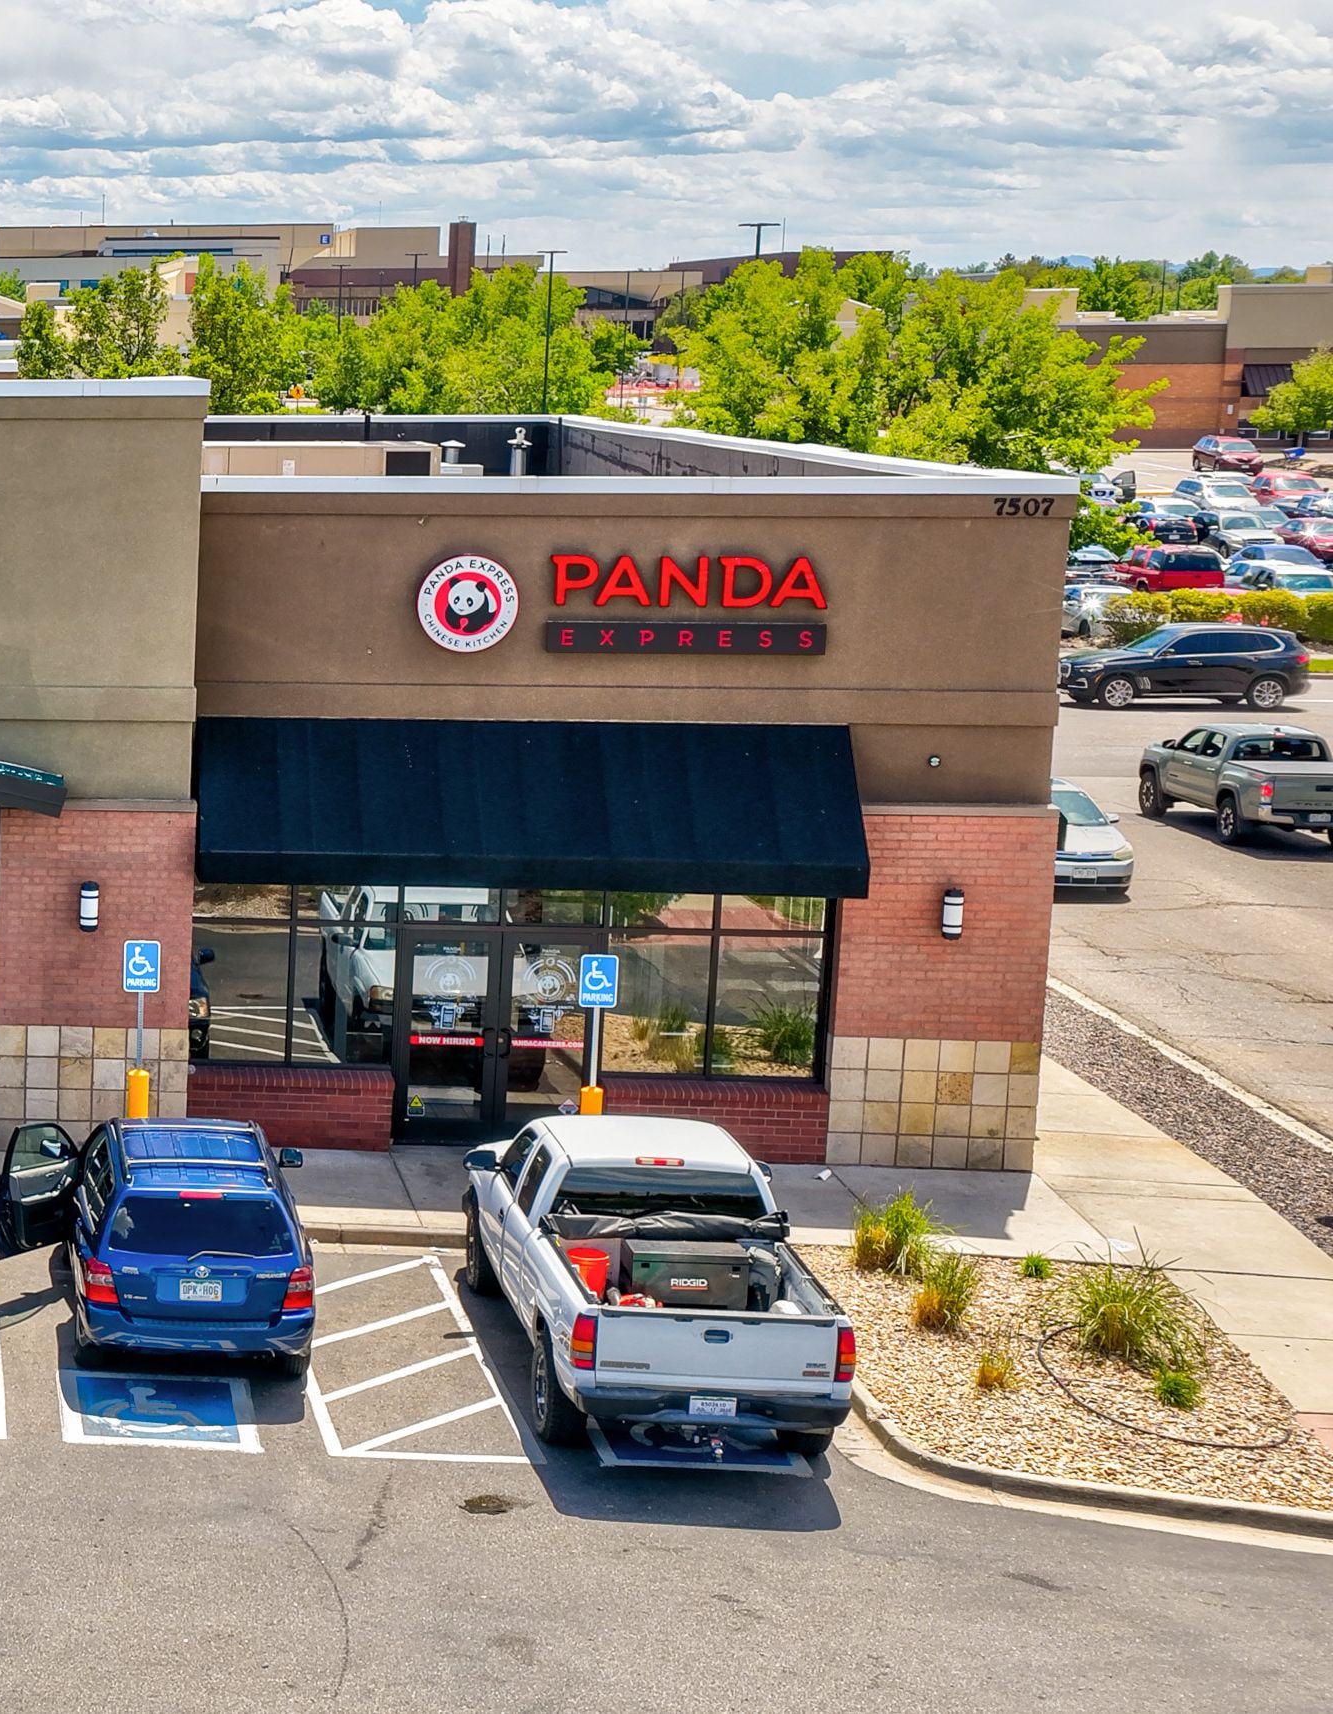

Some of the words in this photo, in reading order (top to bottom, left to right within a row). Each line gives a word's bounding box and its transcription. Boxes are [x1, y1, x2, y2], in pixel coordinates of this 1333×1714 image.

[993, 497, 1055, 517] 7507
[423, 561, 464, 596] PANDA
[469, 559, 515, 603] EXPRESS
[550, 554, 828, 609] PANDA
[424, 613, 460, 648] CHINESE
[465, 620, 508, 648] KITCHEN
[560, 629, 814, 649] EXPRESS
[126, 977, 157, 987] PARKING
[582, 993, 614, 1003] PARKING
[419, 1036, 441, 1045] NOW
[443, 1037, 476, 1046] HIRING
[670, 1277, 708, 1287] RIDGID
